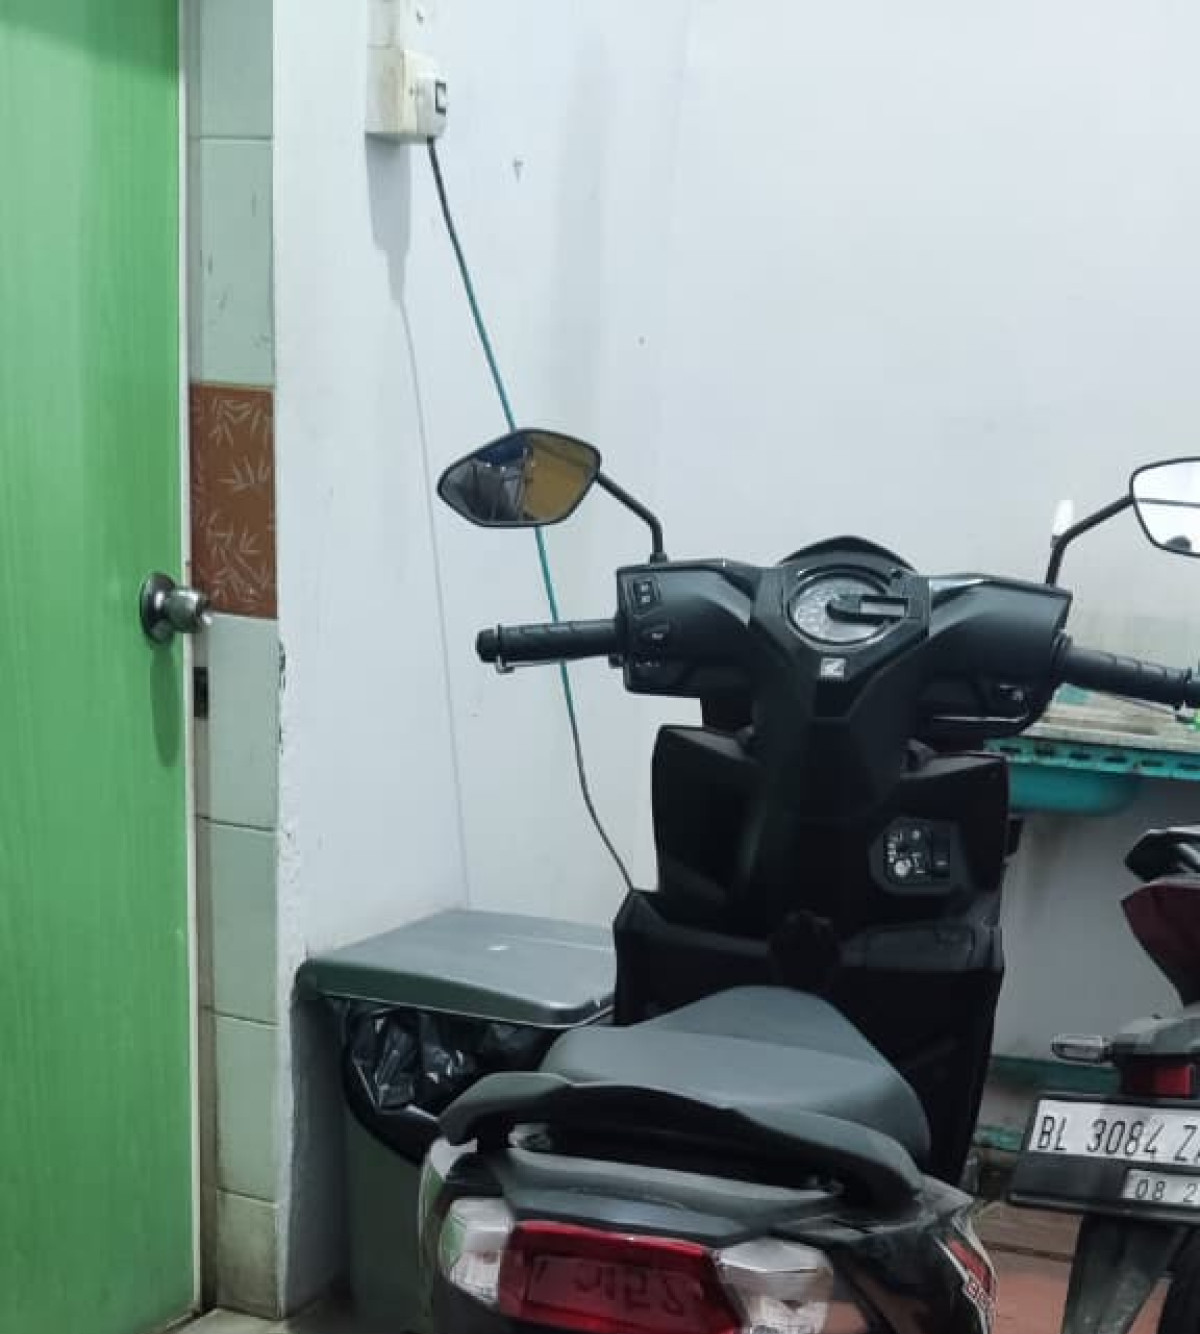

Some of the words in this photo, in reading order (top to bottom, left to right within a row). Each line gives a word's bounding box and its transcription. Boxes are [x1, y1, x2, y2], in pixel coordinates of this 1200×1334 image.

[1037, 1115, 1067, 1151] BL
[1086, 1118, 1165, 1161] 3084
[1173, 1124, 1200, 1164] Z
[1134, 1179, 1166, 1201] 08
